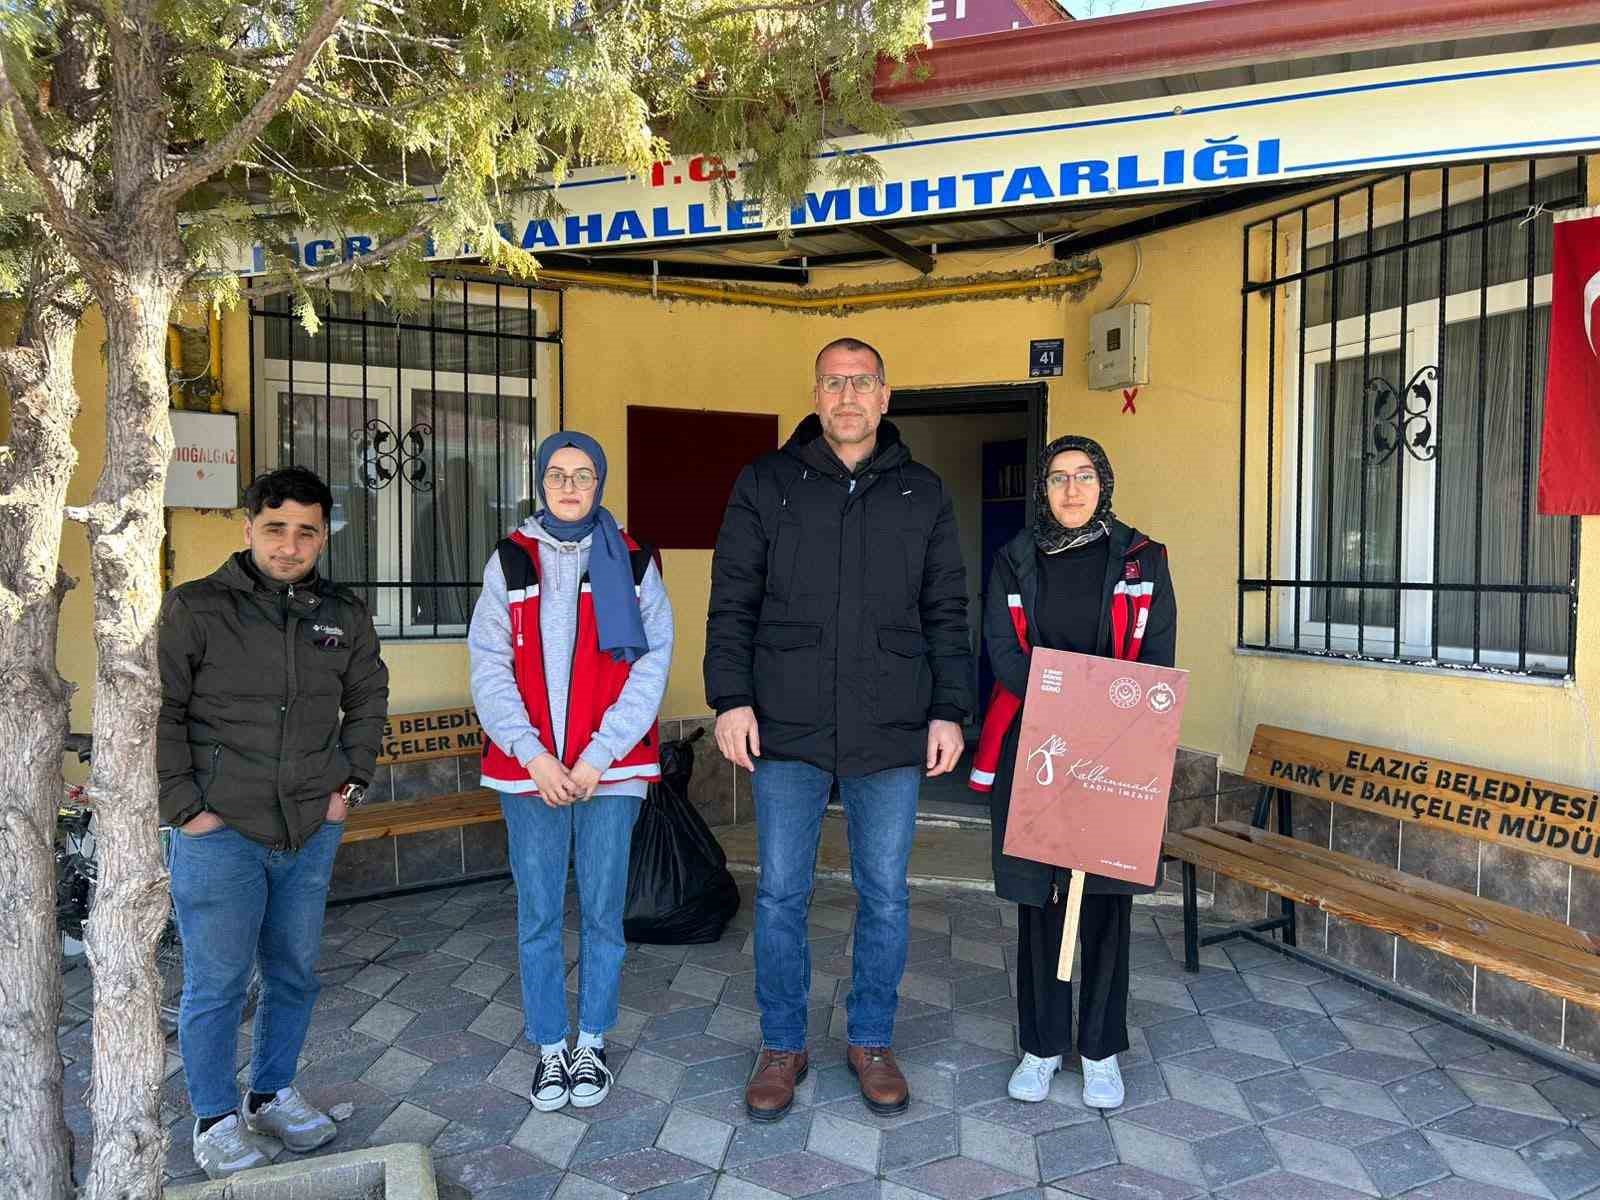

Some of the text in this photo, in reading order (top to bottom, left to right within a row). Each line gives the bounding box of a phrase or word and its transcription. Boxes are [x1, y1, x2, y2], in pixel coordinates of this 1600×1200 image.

[789, 134, 1280, 226] MUHTARLIĞI
[1039, 351, 1055, 364] 41
[1269, 759, 1324, 788] PARK
[1328, 772, 1356, 796] VE
[1360, 781, 1491, 831] BAHÇELER
[1346, 750, 1599, 823] ELAZIĞ BELEDİYESİ
